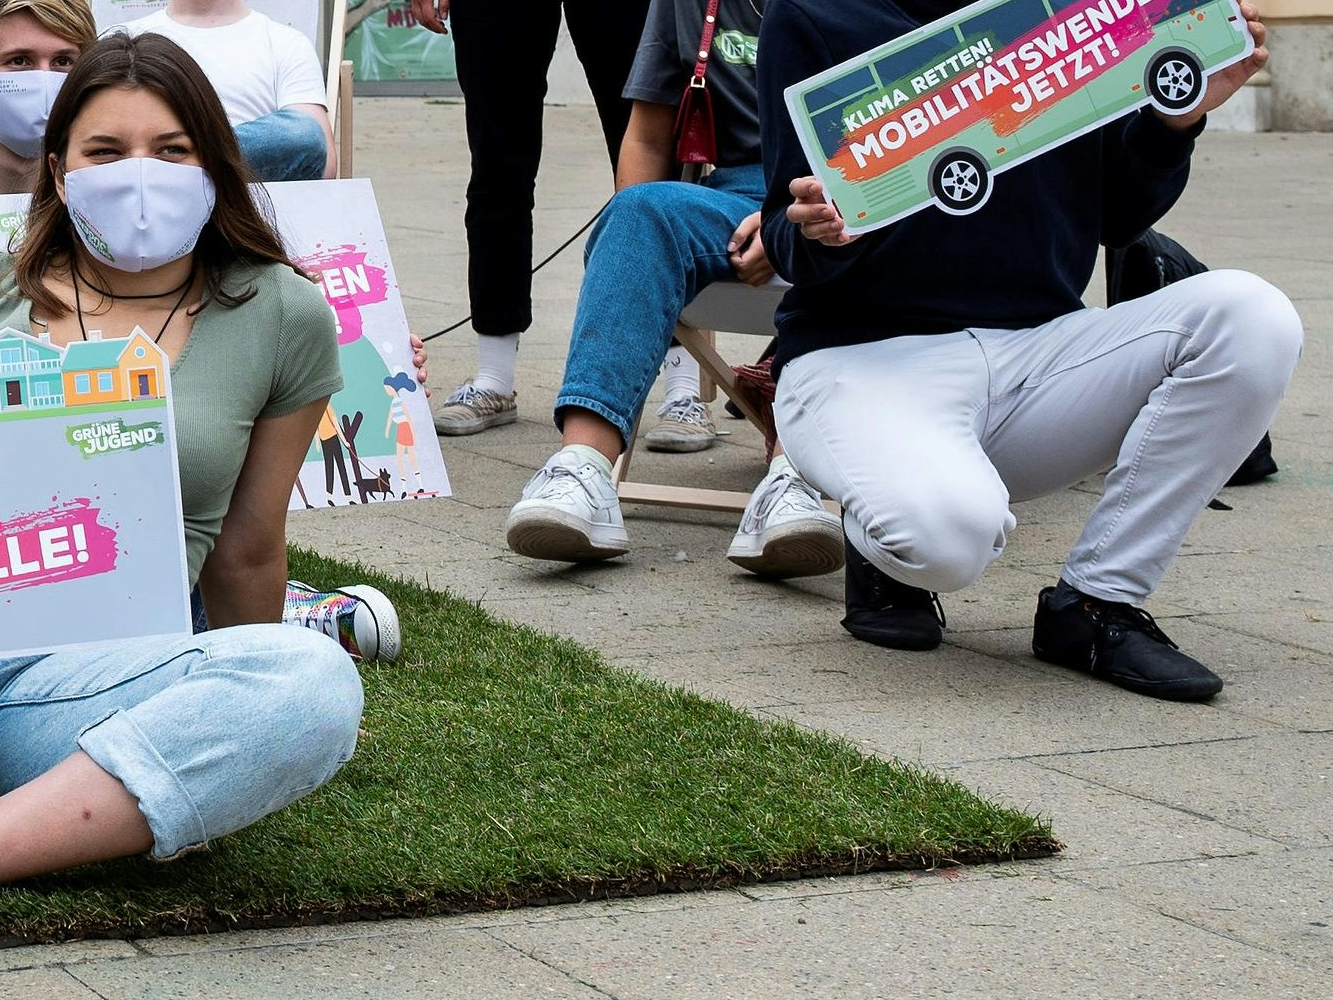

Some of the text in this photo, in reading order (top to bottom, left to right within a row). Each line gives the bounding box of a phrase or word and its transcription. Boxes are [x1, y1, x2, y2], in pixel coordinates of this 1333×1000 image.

[843, 37, 994, 132] KLIMA RETTEN!
[1010, 33, 1121, 113] JETZT!
[73, 423, 120, 441] GRÜNE
[84, 427, 157, 454] JUGEND
